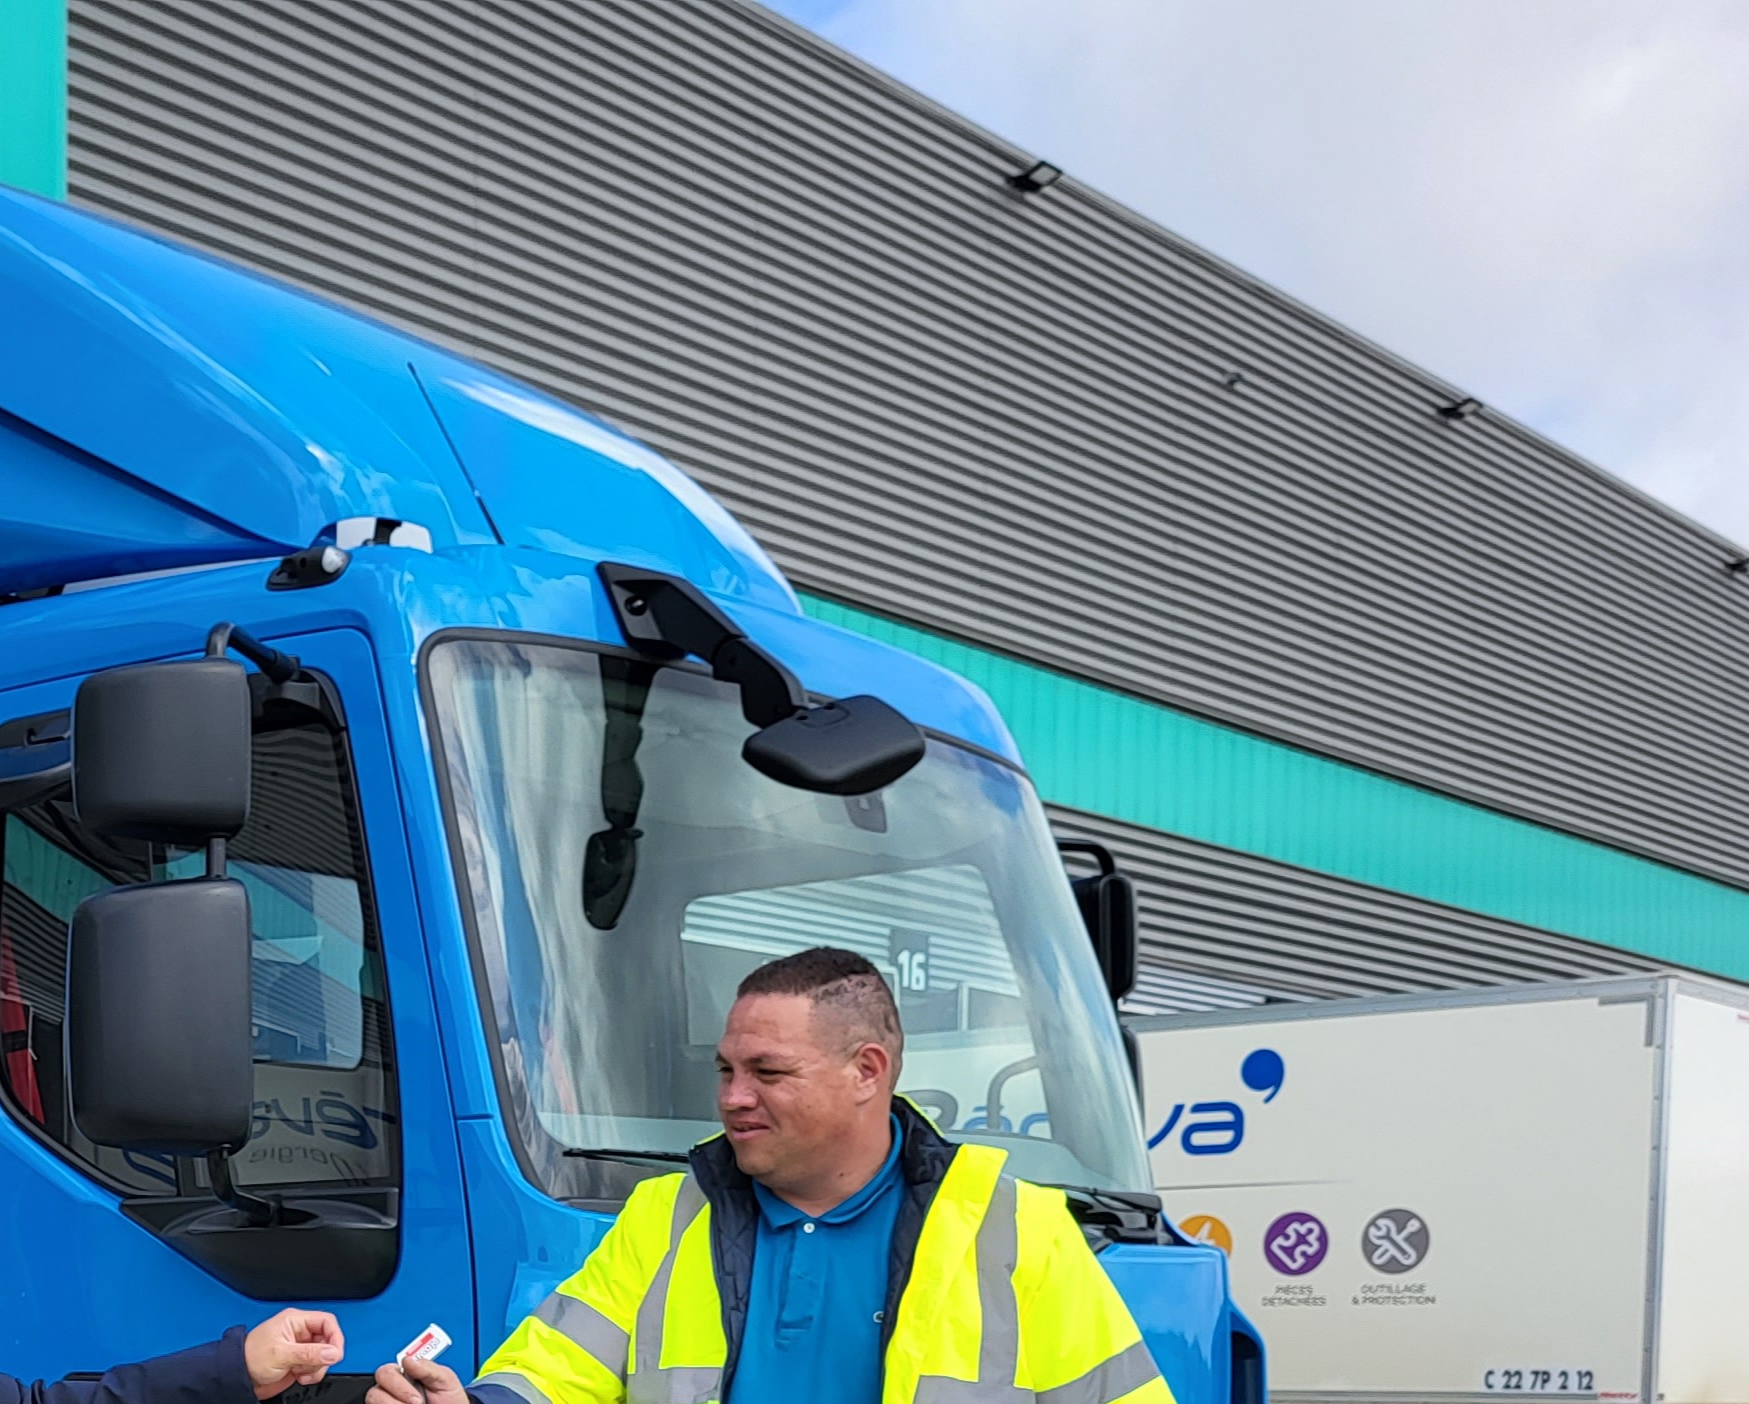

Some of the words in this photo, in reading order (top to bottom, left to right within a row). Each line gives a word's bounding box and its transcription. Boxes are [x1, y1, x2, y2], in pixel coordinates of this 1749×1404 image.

[897, 949, 926, 991] 16
[1484, 1370, 1495, 1389] C
[1501, 1370, 1523, 1390] 22
[1558, 1370, 1569, 1390] 2
[1576, 1370, 1594, 1390] 12
